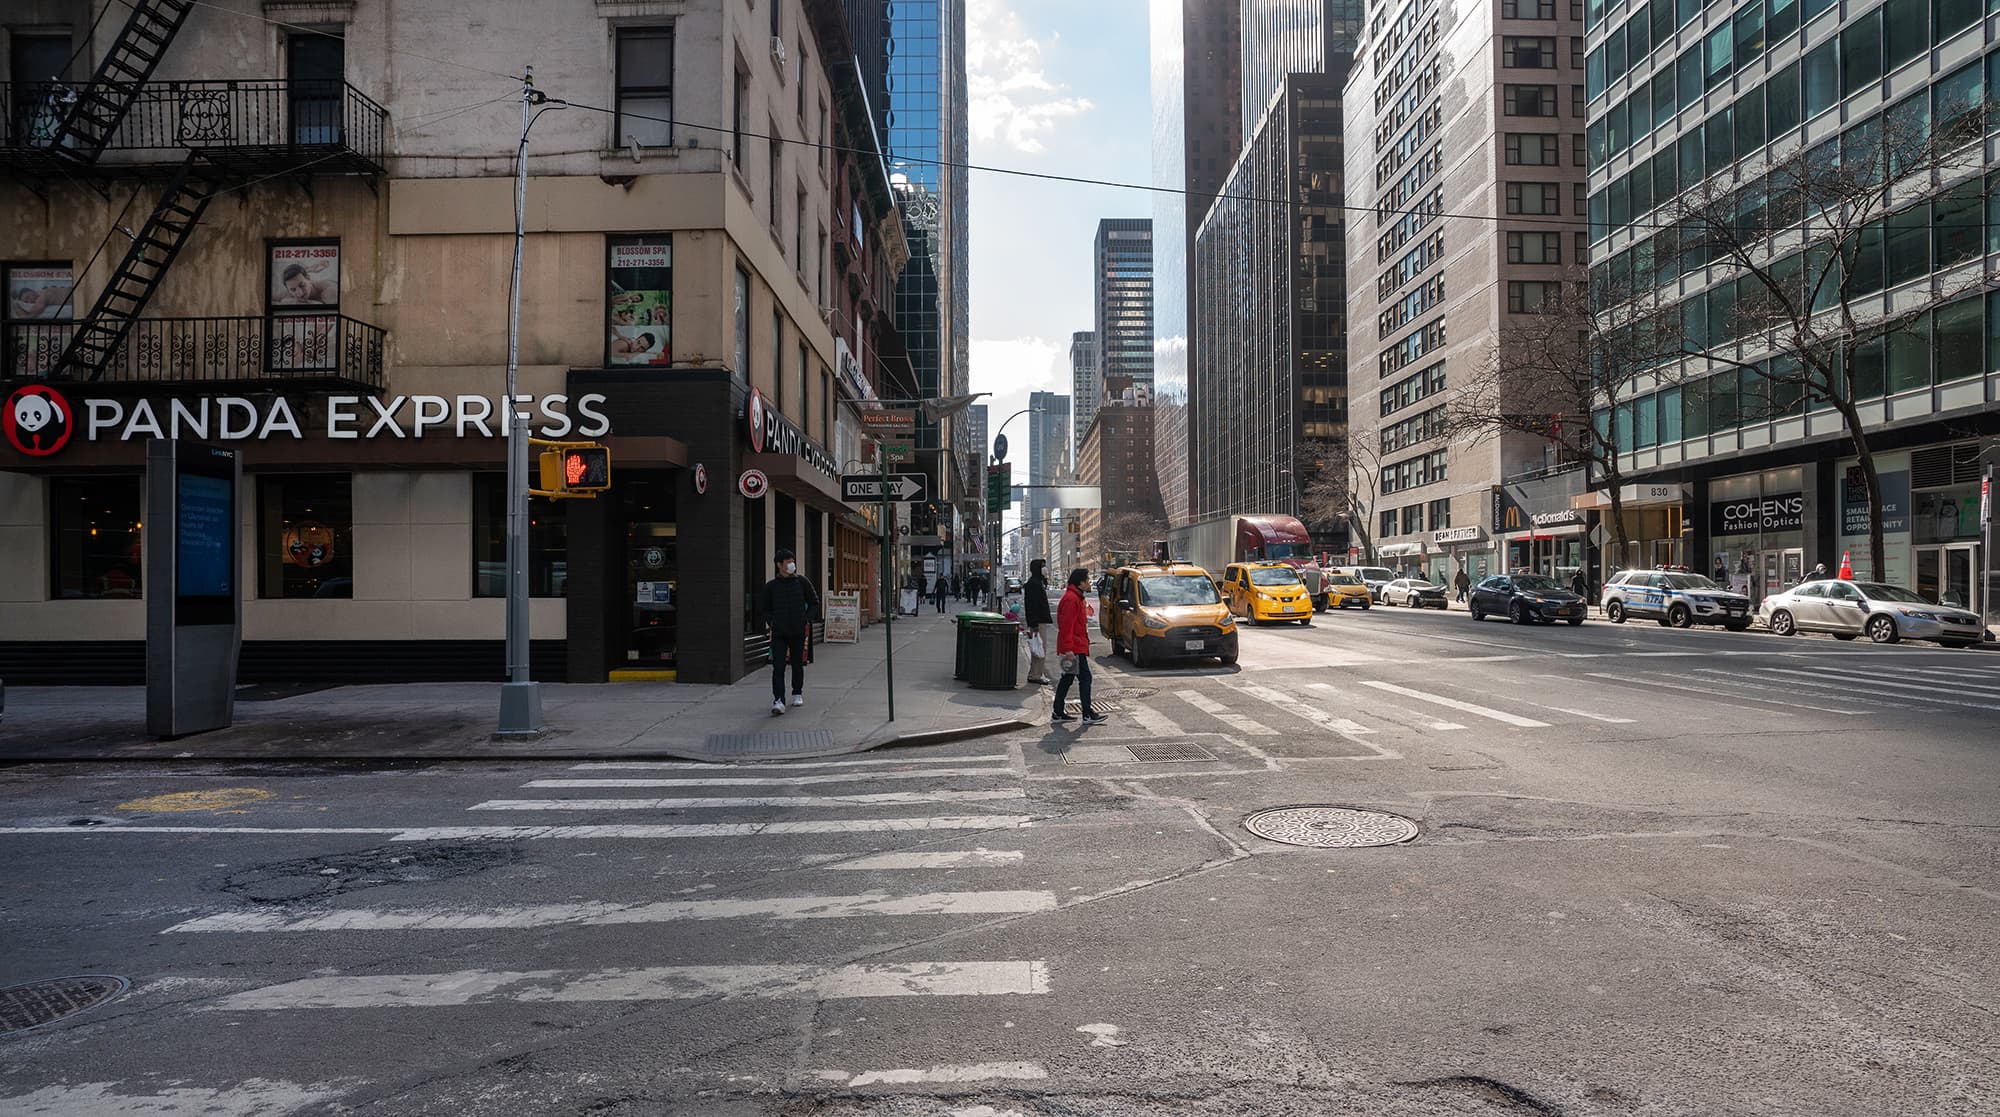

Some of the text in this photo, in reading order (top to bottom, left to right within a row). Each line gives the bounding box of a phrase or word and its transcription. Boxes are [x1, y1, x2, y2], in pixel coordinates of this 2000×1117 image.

[617, 246, 666, 256] BLOSSOM SPA
[617, 258, 665, 266] 212-271-3356
[84, 394, 610, 441] PANDA EXPRESS
[890, 454, 904, 462] Spa
[850, 483, 872, 494] ONE
[1650, 488, 1668, 497] 830
[1724, 497, 1803, 520] COHEN'S
[1846, 507, 1870, 516] SMALL
[1724, 514, 1804, 532] Fashion Optical
[1846, 520, 1902, 532] OPPONITY
[1644, 593, 1665, 604] NYPD
